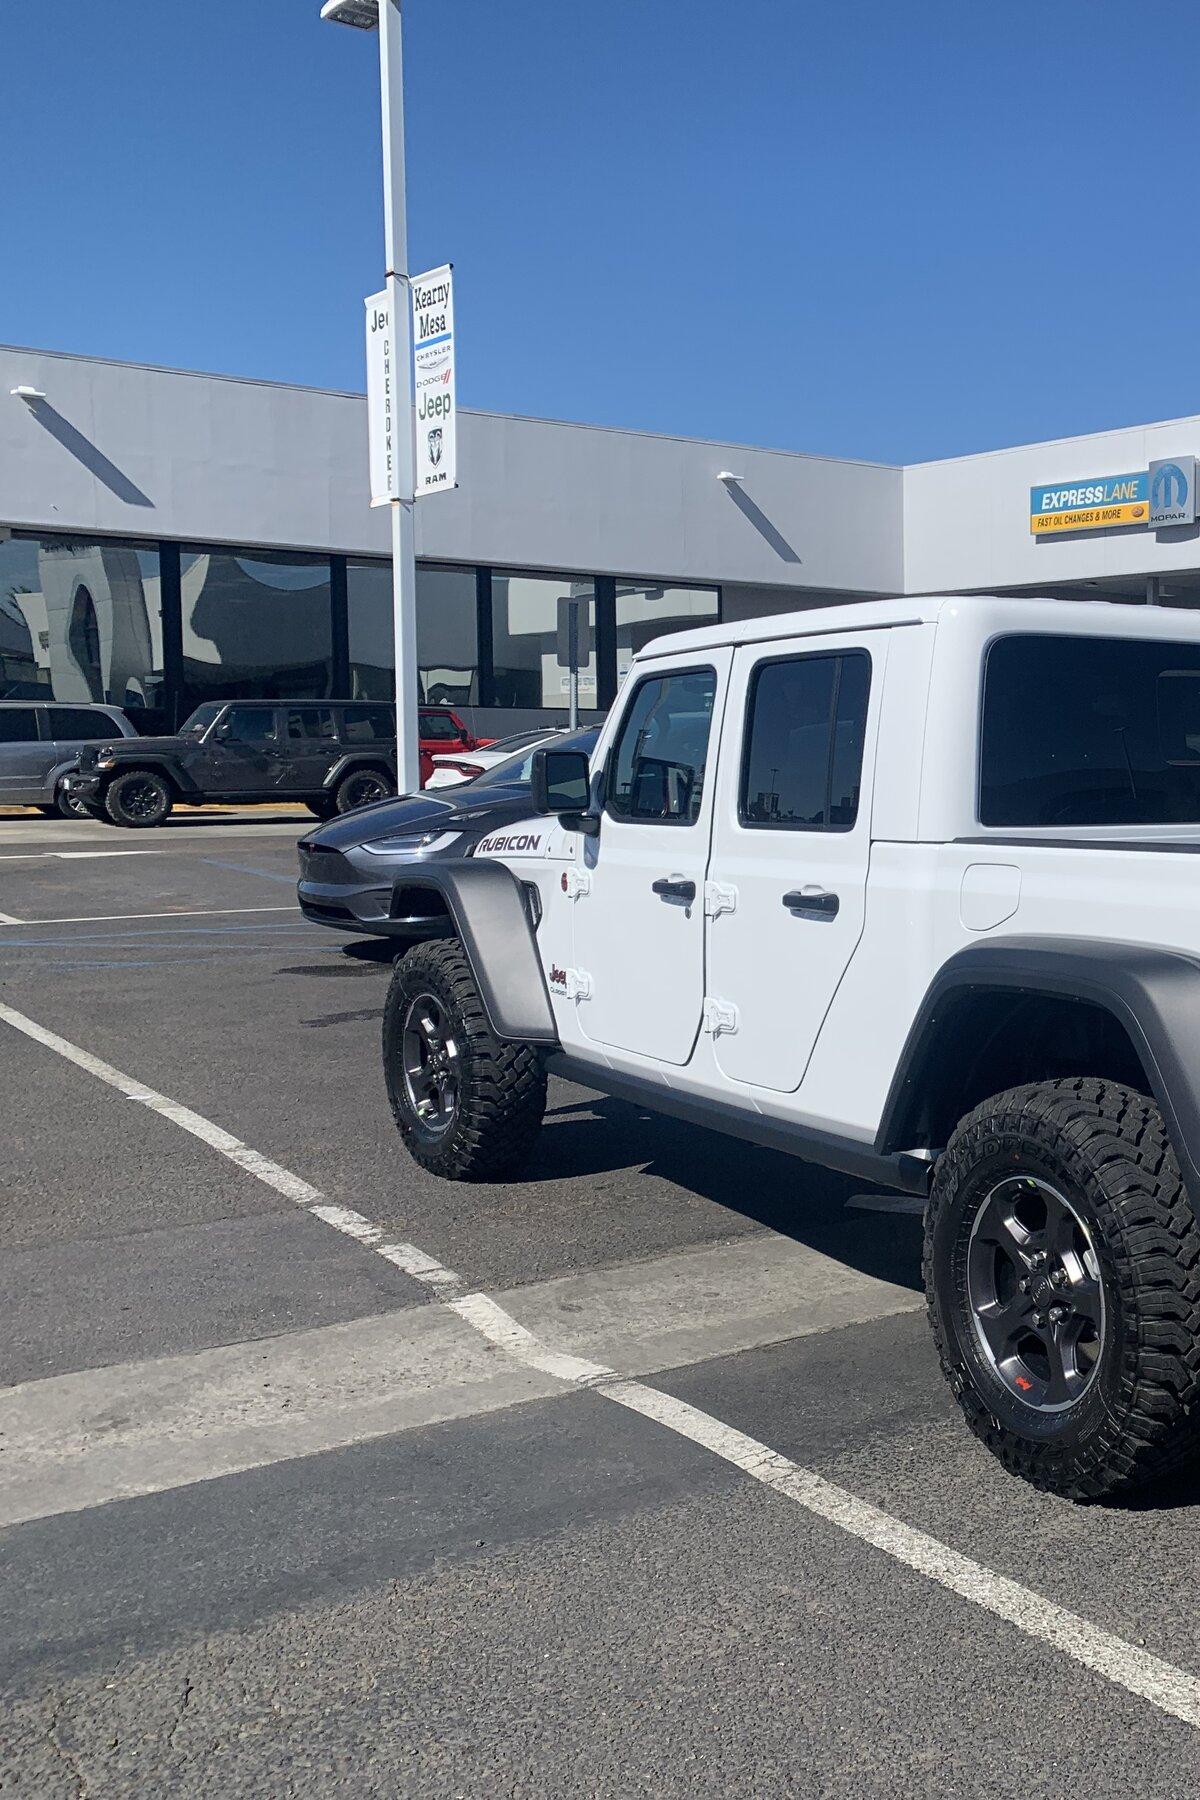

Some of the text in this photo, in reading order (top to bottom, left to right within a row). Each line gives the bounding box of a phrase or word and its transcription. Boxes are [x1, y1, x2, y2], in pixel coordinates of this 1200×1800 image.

[415, 281, 450, 312] Kearny
[419, 314, 446, 339] Mesa
[416, 345, 452, 362] CHRYSLER
[383, 339, 393, 492] CHEROKEE
[418, 392, 452, 421] Jeep
[425, 472, 447, 485] RAM
[1037, 508, 1122, 527] FAST OIL CHANGES & MORE
[1151, 512, 1186, 522] MOPAR
[478, 834, 542, 853] RUBICON
